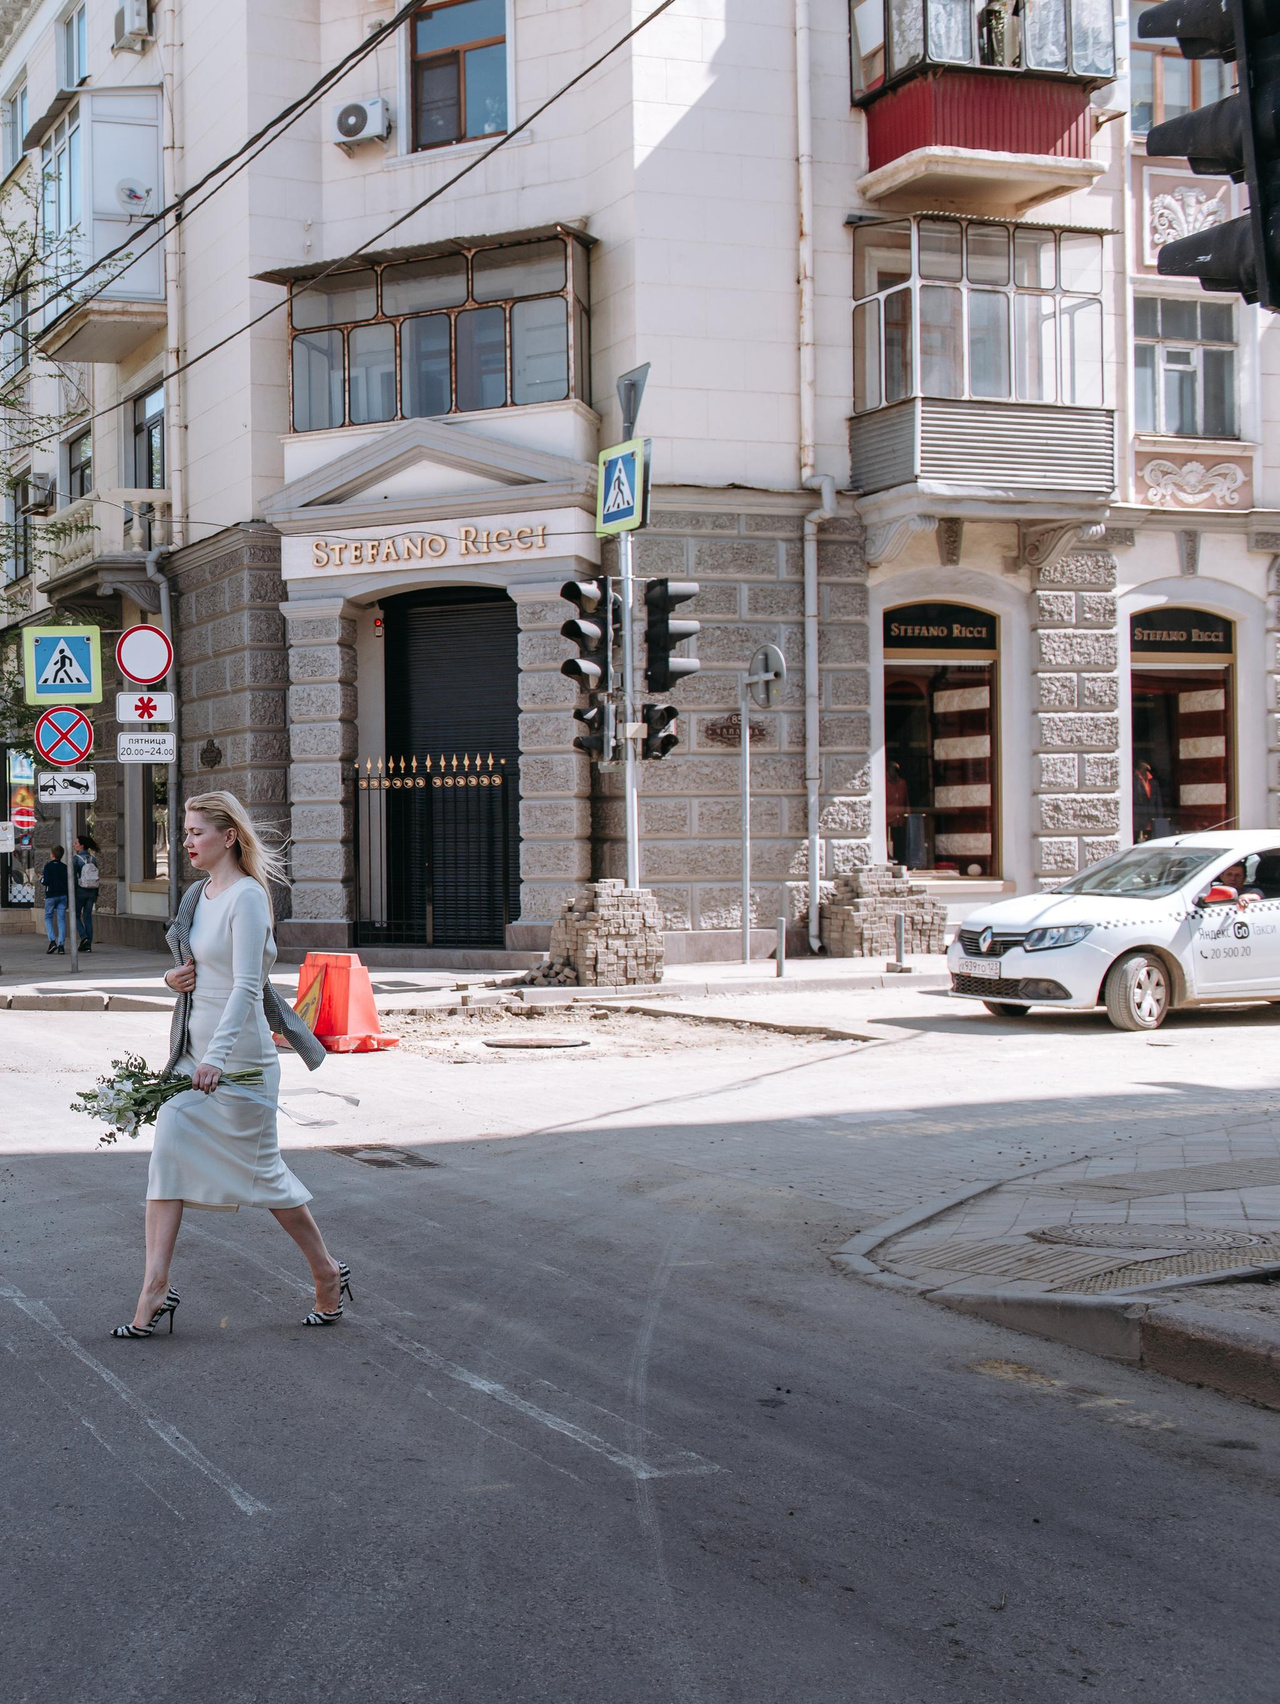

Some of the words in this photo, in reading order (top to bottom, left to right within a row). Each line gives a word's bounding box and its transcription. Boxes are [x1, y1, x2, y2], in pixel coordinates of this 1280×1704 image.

[312, 534, 447, 568] STEFANO
[458, 524, 547, 555] RICCI
[890, 622, 948, 637] STEFANO
[952, 623, 987, 638] RICCI
[1134, 627, 1188, 641] STEFANO
[1191, 628, 1224, 642] RICCI
[716, 727, 759, 735] ЧАПАВА
[120, 747, 174, 756] 20.00-24.00
[1198, 927, 1231, 940] Яндекс
[1234, 922, 1250, 939] Go
[1251, 923, 1277, 936] Такси
[1211, 948, 1221, 959] 20
[1223, 946, 1239, 958] 500
[1240, 945, 1251, 957] 20
